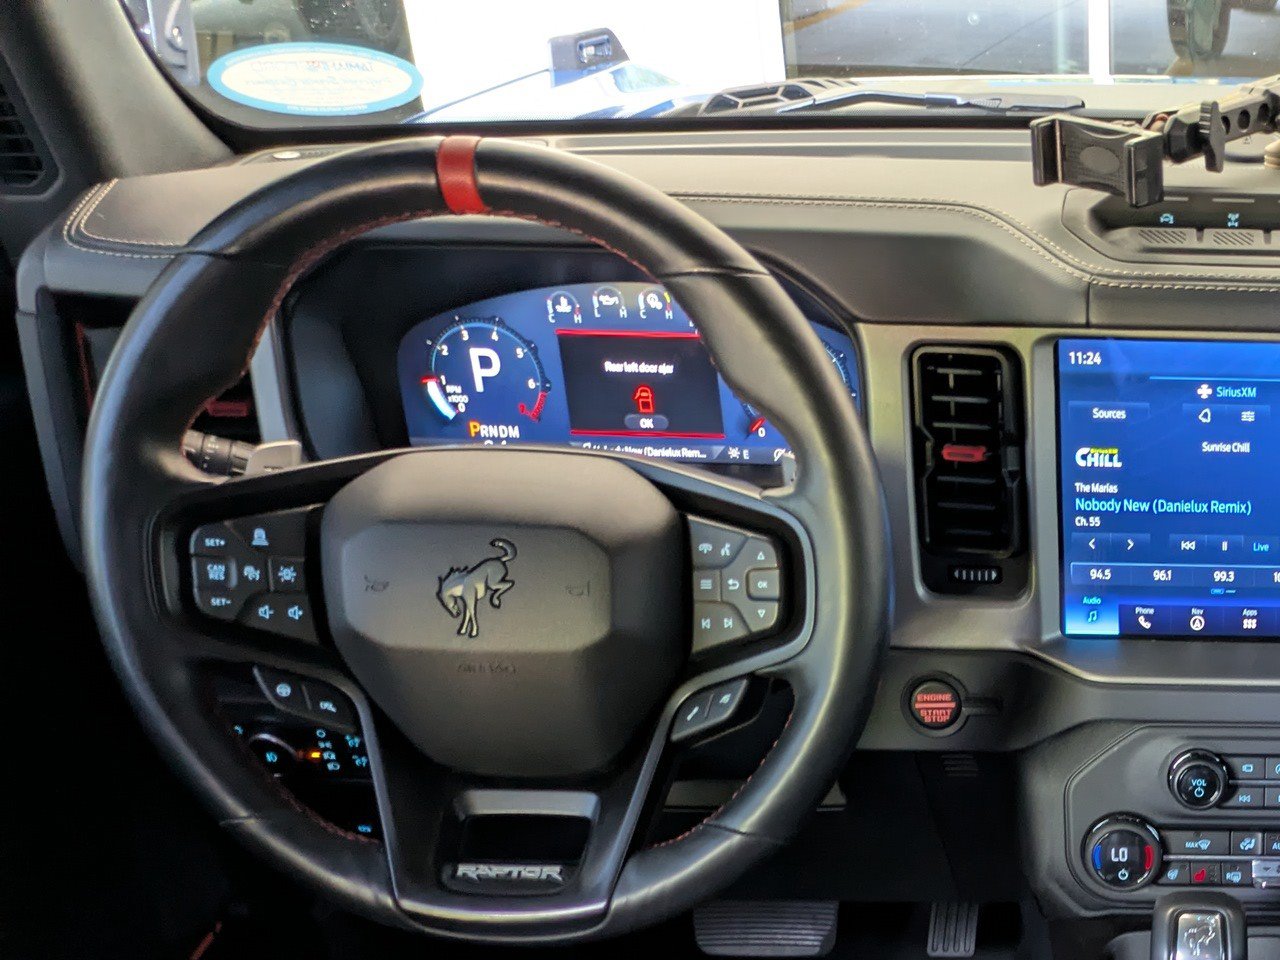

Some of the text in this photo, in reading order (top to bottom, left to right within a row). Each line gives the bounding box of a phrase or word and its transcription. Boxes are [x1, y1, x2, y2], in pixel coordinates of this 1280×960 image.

[574, 314, 582, 324] H
[665, 310, 673, 320] H
[460, 329, 470, 341] 3
[490, 330, 499, 342] 4
[440, 344, 449, 356] 2
[516, 346, 524, 358] 5
[1069, 350, 1102, 366] 11:24
[469, 346, 501, 393] P
[446, 384, 462, 394] RPM
[526, 378, 536, 390] 6
[1216, 386, 1257, 398] SiriusXM
[457, 402, 466, 413] 0
[1092, 408, 1126, 420] Sources
[640, 418, 654, 430] OK
[758, 427, 766, 438] 0
[1202, 442, 1250, 453] Sunrise Chill
[742, 448, 750, 460] E
[1074, 482, 1090, 493] The
[1076, 498, 1252, 516] Nobody New (Danielux Remix)
[1075, 516, 1101, 527] Ch. 55
[1253, 542, 1270, 552] Live
[1090, 568, 1112, 580] 94.5
[1153, 570, 1172, 582] 96.1
[1214, 571, 1235, 582] 99.3
[757, 580, 768, 589] OK
[1082, 596, 1102, 605] Audio
[1135, 606, 1154, 615] Phone
[1242, 608, 1258, 617] Apps
[916, 693, 952, 702] ENGINE
[920, 708, 952, 716] START
[1192, 778, 1206, 787] VOL
[1110, 846, 1128, 862] LO
[456, 863, 564, 882] RAPTOR
